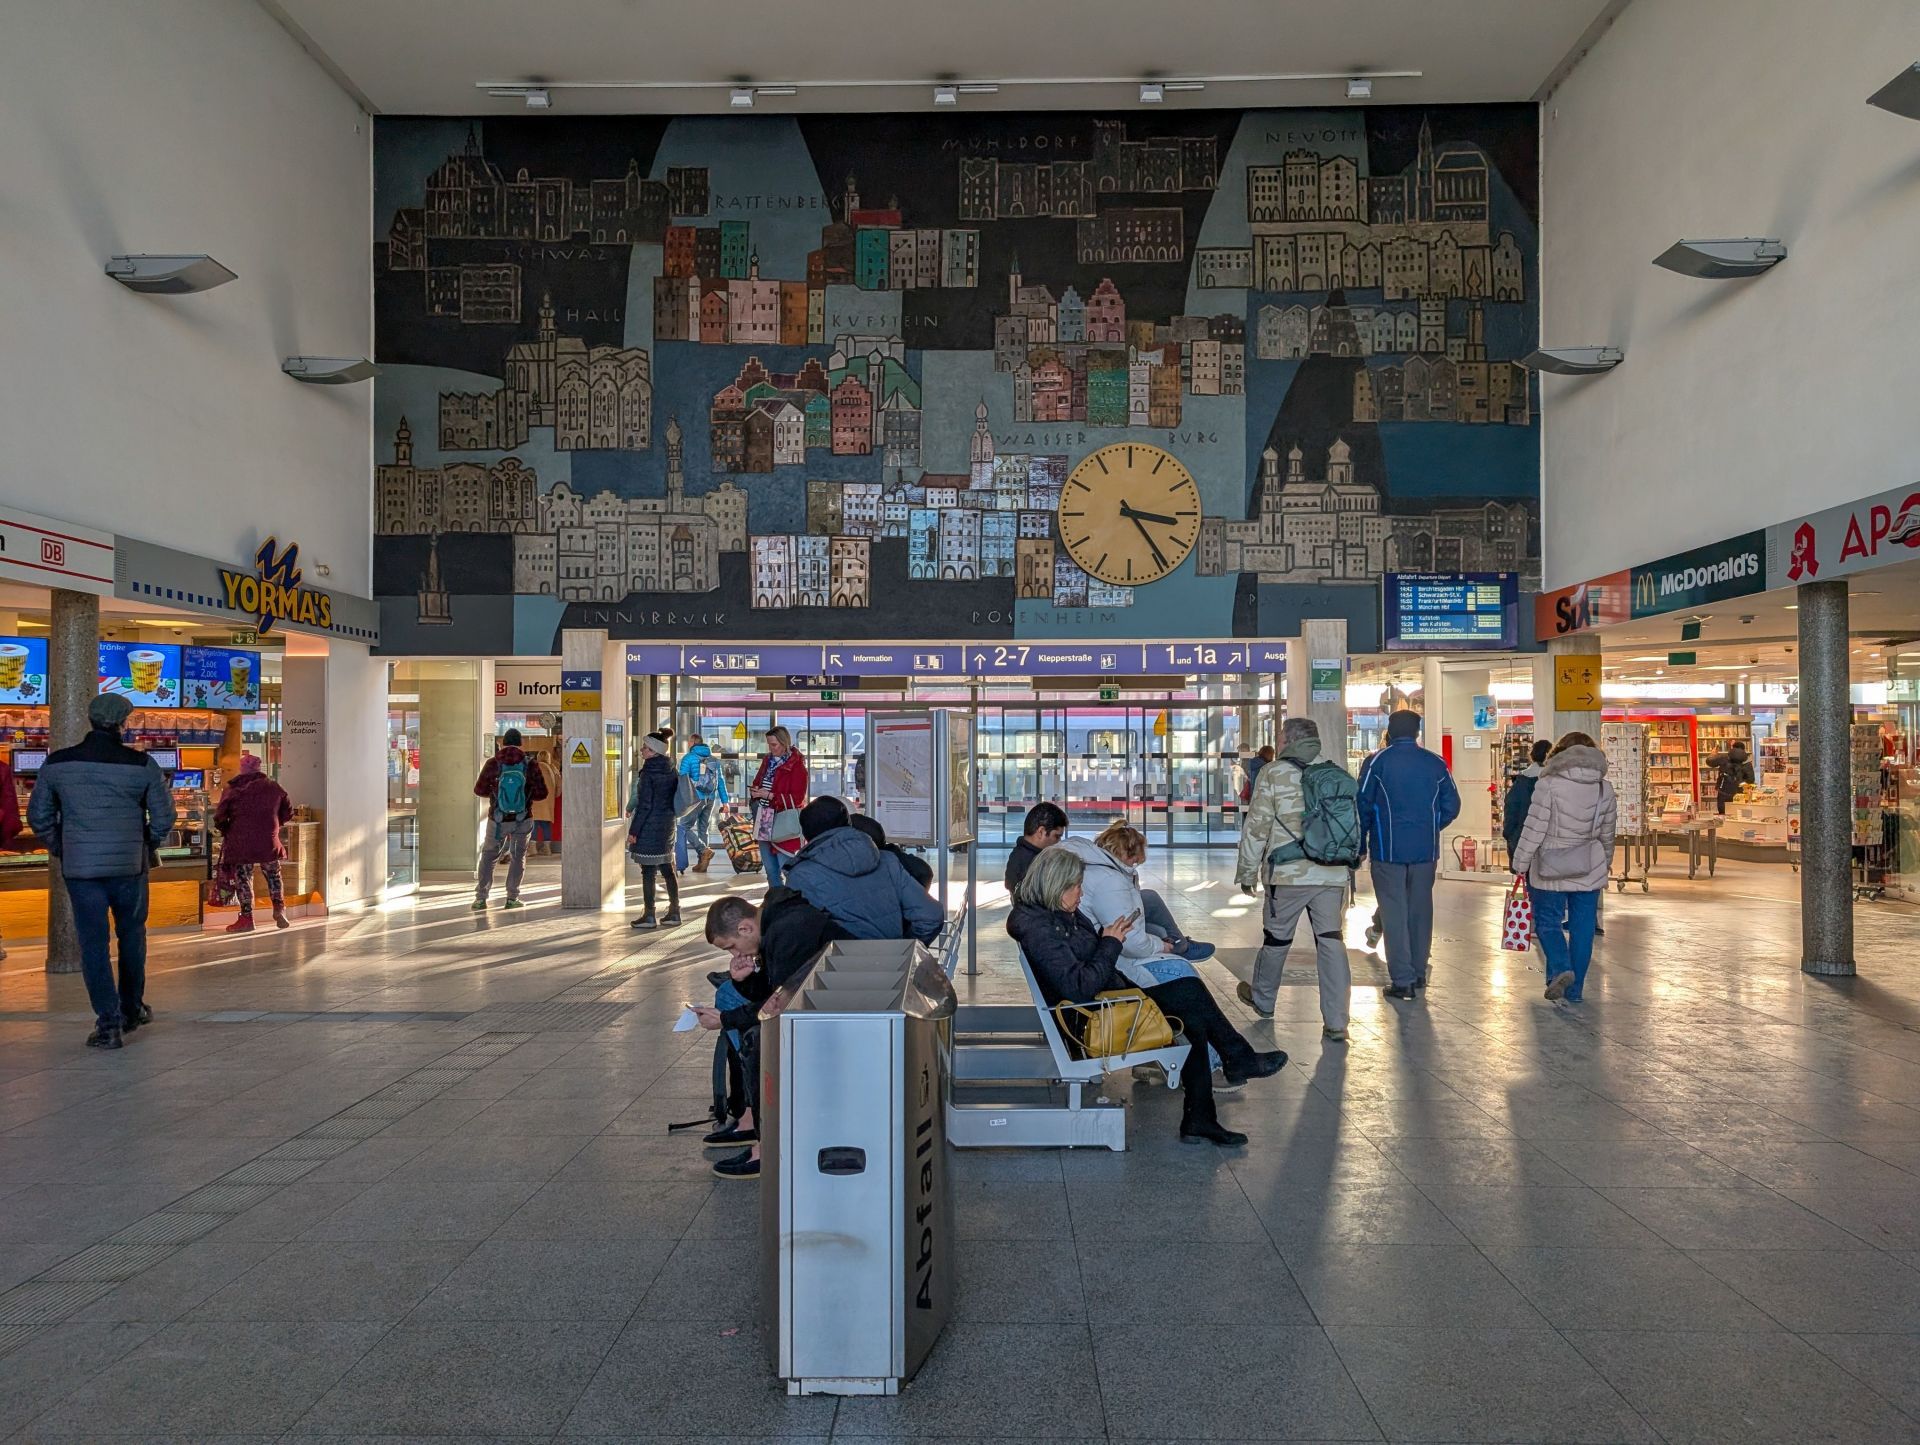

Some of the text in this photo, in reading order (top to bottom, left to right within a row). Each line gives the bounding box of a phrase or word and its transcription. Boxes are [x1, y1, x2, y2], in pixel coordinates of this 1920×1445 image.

[504, 246, 608, 262] SCHWAZ
[566, 309, 622, 323] HALL
[997, 430, 1088, 446] WASSER
[1660, 552, 1759, 597] McDonald's
[222, 570, 333, 628] YORMA'S
[971, 611, 1119, 625] ROSENHEIM
[627, 654, 641, 662] Ost
[853, 654, 893, 663] Information
[994, 646, 1093, 667] 2-7 Klepperstraße
[1166, 645, 1217, 664] 1 und 1a
[286, 719, 321, 728] Vitamin-
[290, 727, 318, 735] station
[851, 732, 865, 752] 2
[915, 1117, 934, 1310] Abfall
